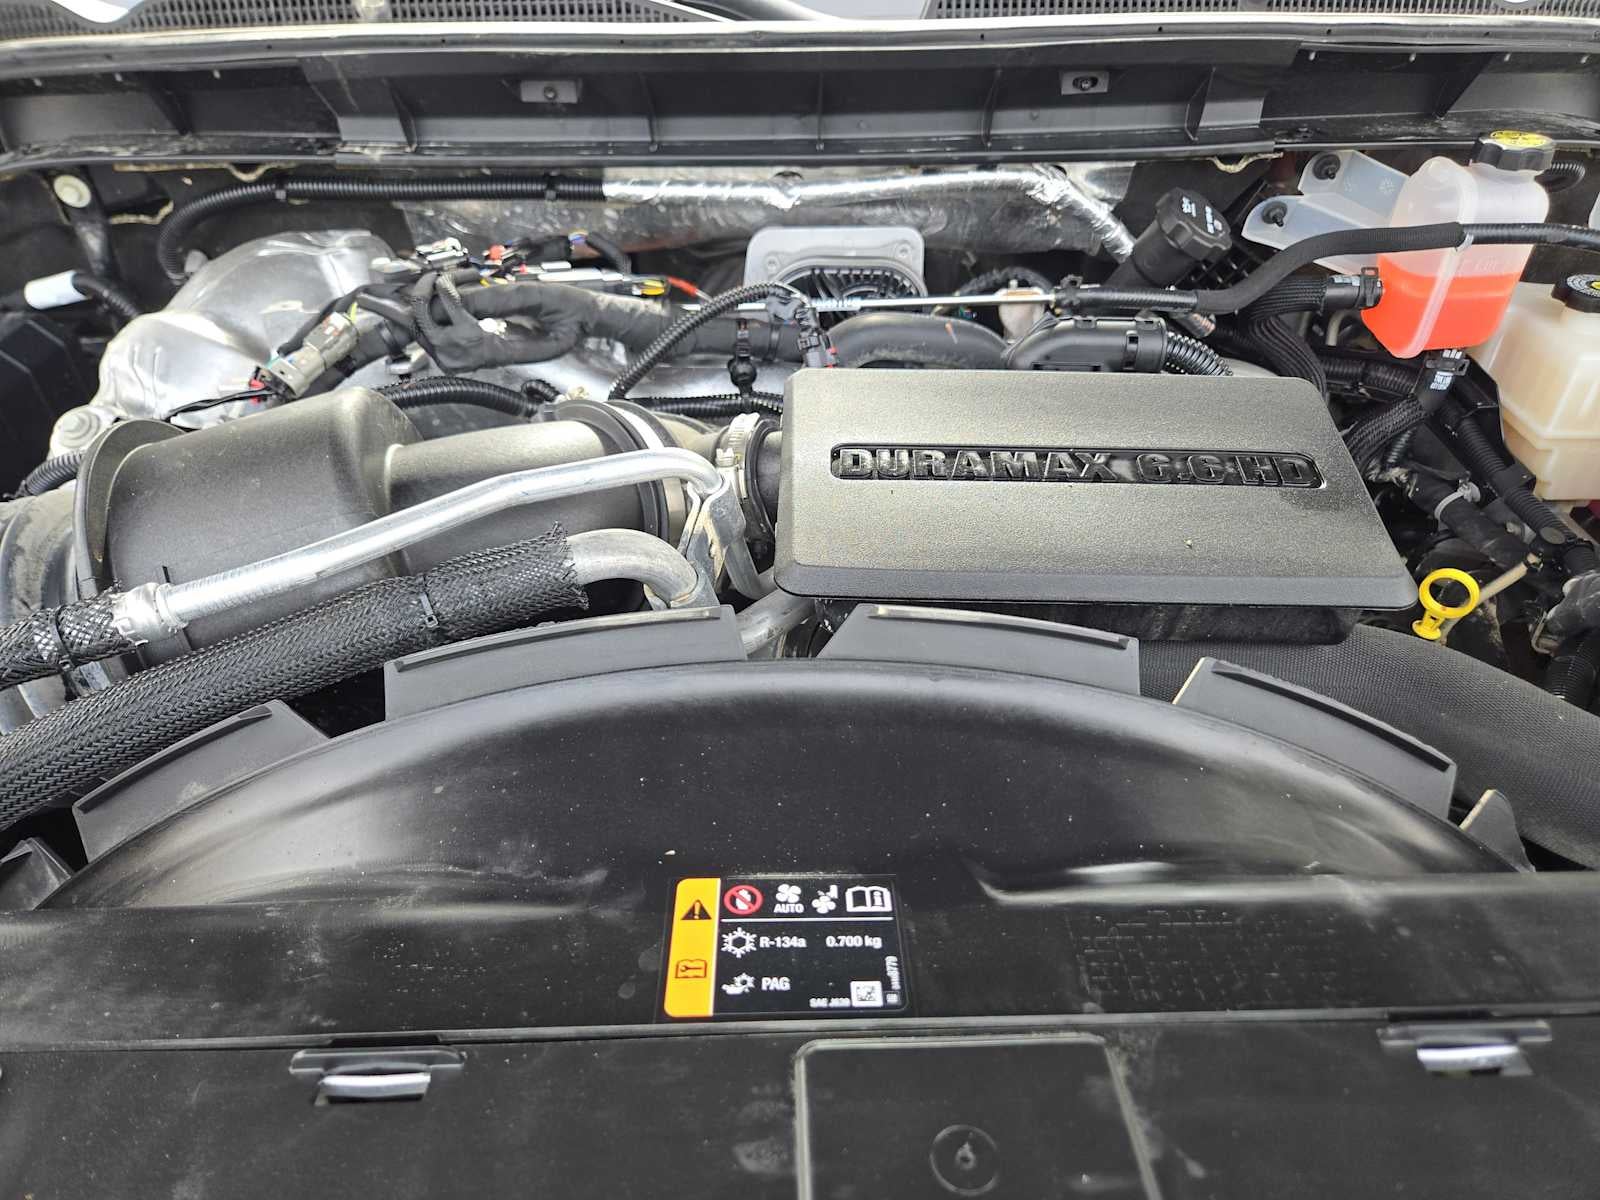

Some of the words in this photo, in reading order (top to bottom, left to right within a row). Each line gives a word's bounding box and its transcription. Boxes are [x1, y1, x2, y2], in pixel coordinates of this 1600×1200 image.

[839, 449, 1118, 483] DURAMAX
[774, 903, 805, 914] AUTO
[759, 936, 807, 948] R-134a
[826, 935, 863, 948] 0.700
[864, 935, 882, 949] kg
[761, 976, 791, 991] PAG
